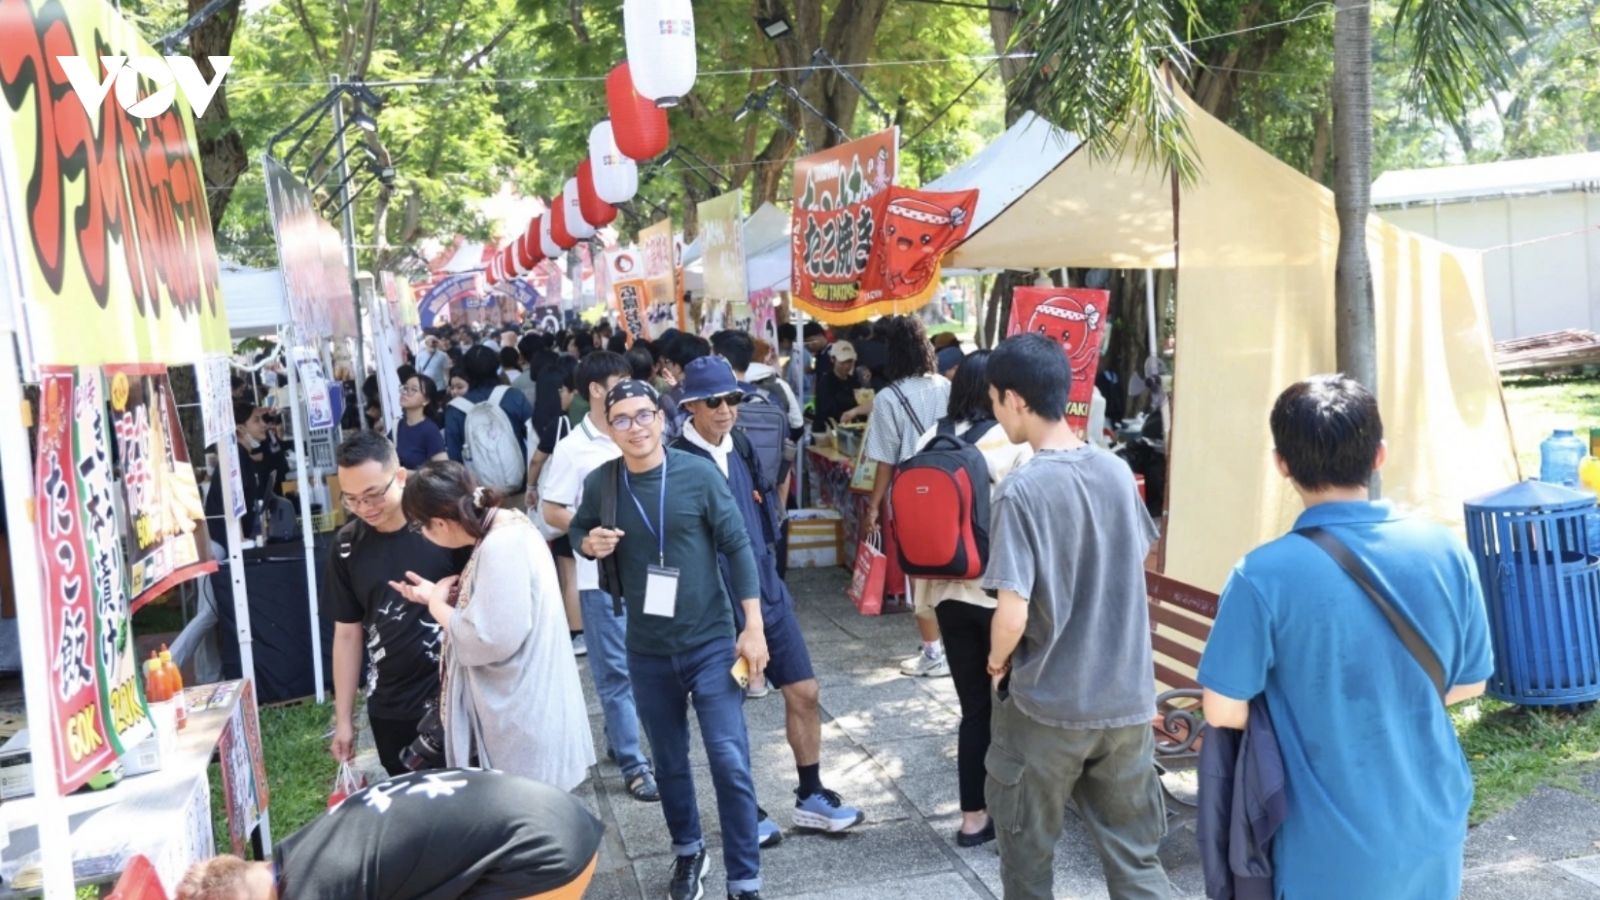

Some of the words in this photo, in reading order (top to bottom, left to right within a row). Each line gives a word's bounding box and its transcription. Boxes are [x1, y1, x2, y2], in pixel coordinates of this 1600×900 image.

[803, 204, 874, 278] たこ焼き
[45, 452, 93, 701] たこ飯
[79, 455, 118, 680] 一本漬け
[67, 702, 104, 763] 60K
[110, 675, 146, 735] 20K
